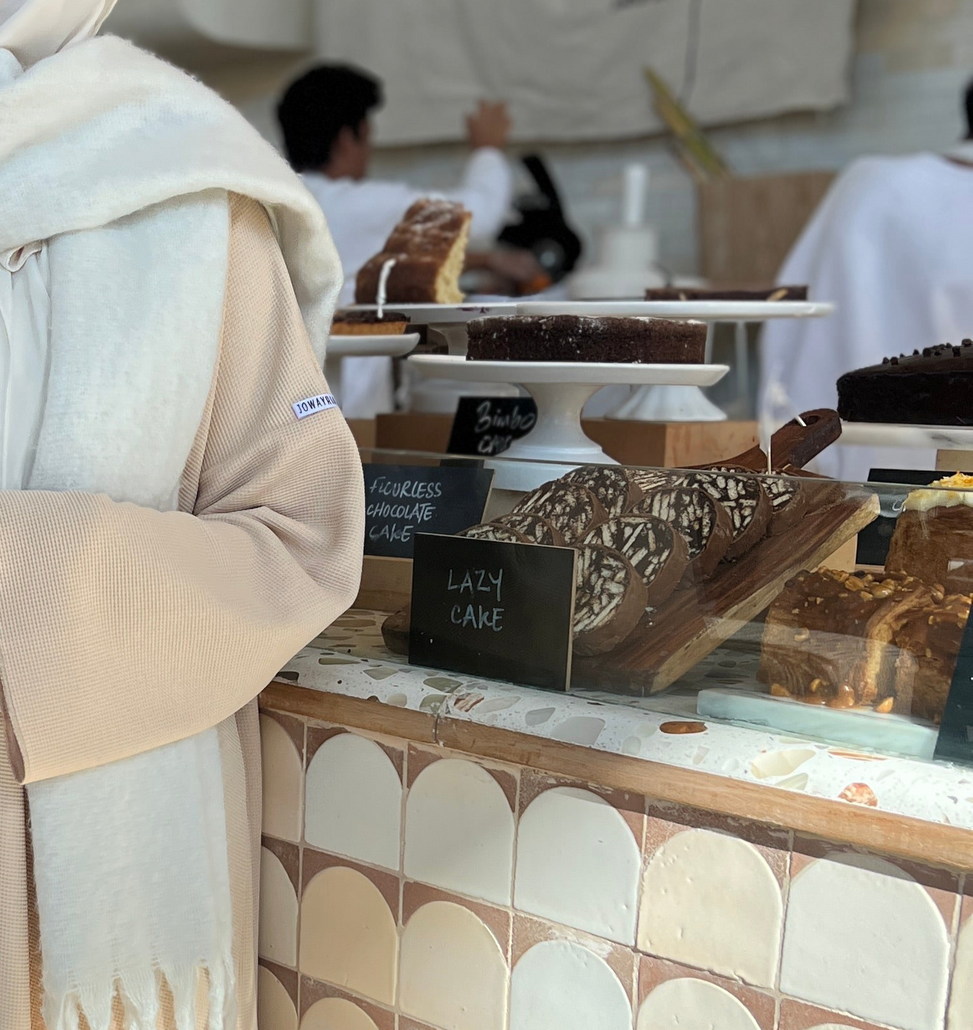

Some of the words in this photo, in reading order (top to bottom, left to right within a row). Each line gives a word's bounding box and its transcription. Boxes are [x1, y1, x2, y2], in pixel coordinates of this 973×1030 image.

[366, 501, 436, 524] CHOCOLATE
[369, 523, 414, 542] CAKE
[448, 568, 503, 602] LAZY
[450, 604, 505, 632] CAKE
